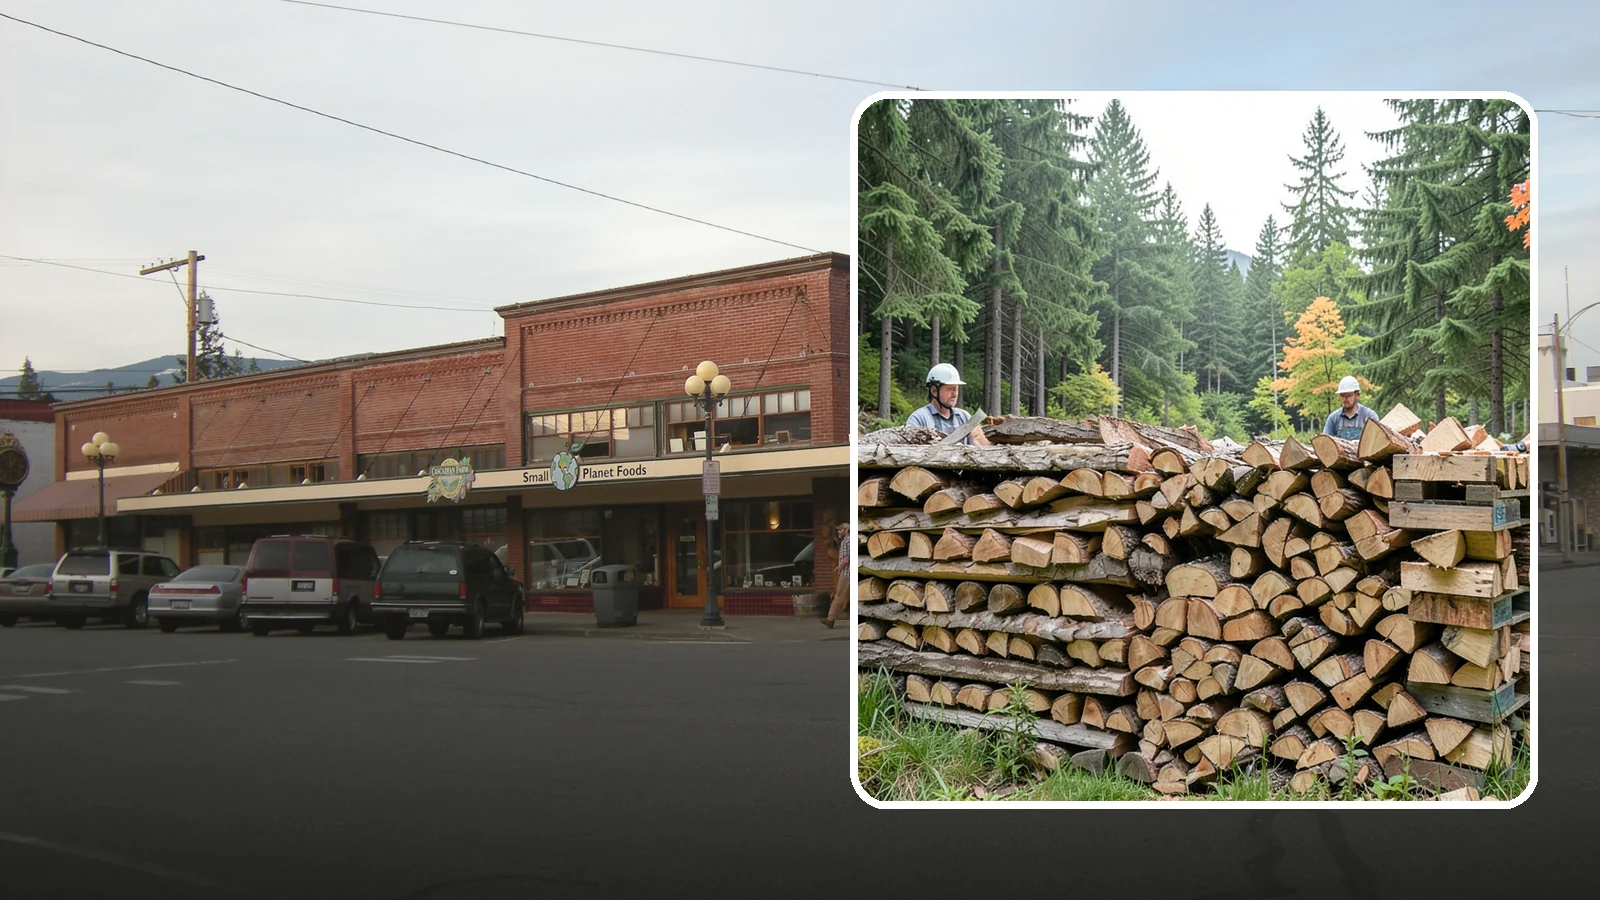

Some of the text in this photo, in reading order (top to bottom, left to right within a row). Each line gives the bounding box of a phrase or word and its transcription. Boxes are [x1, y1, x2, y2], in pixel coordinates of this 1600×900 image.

[523, 464, 647, 483] Small Planet Foods
